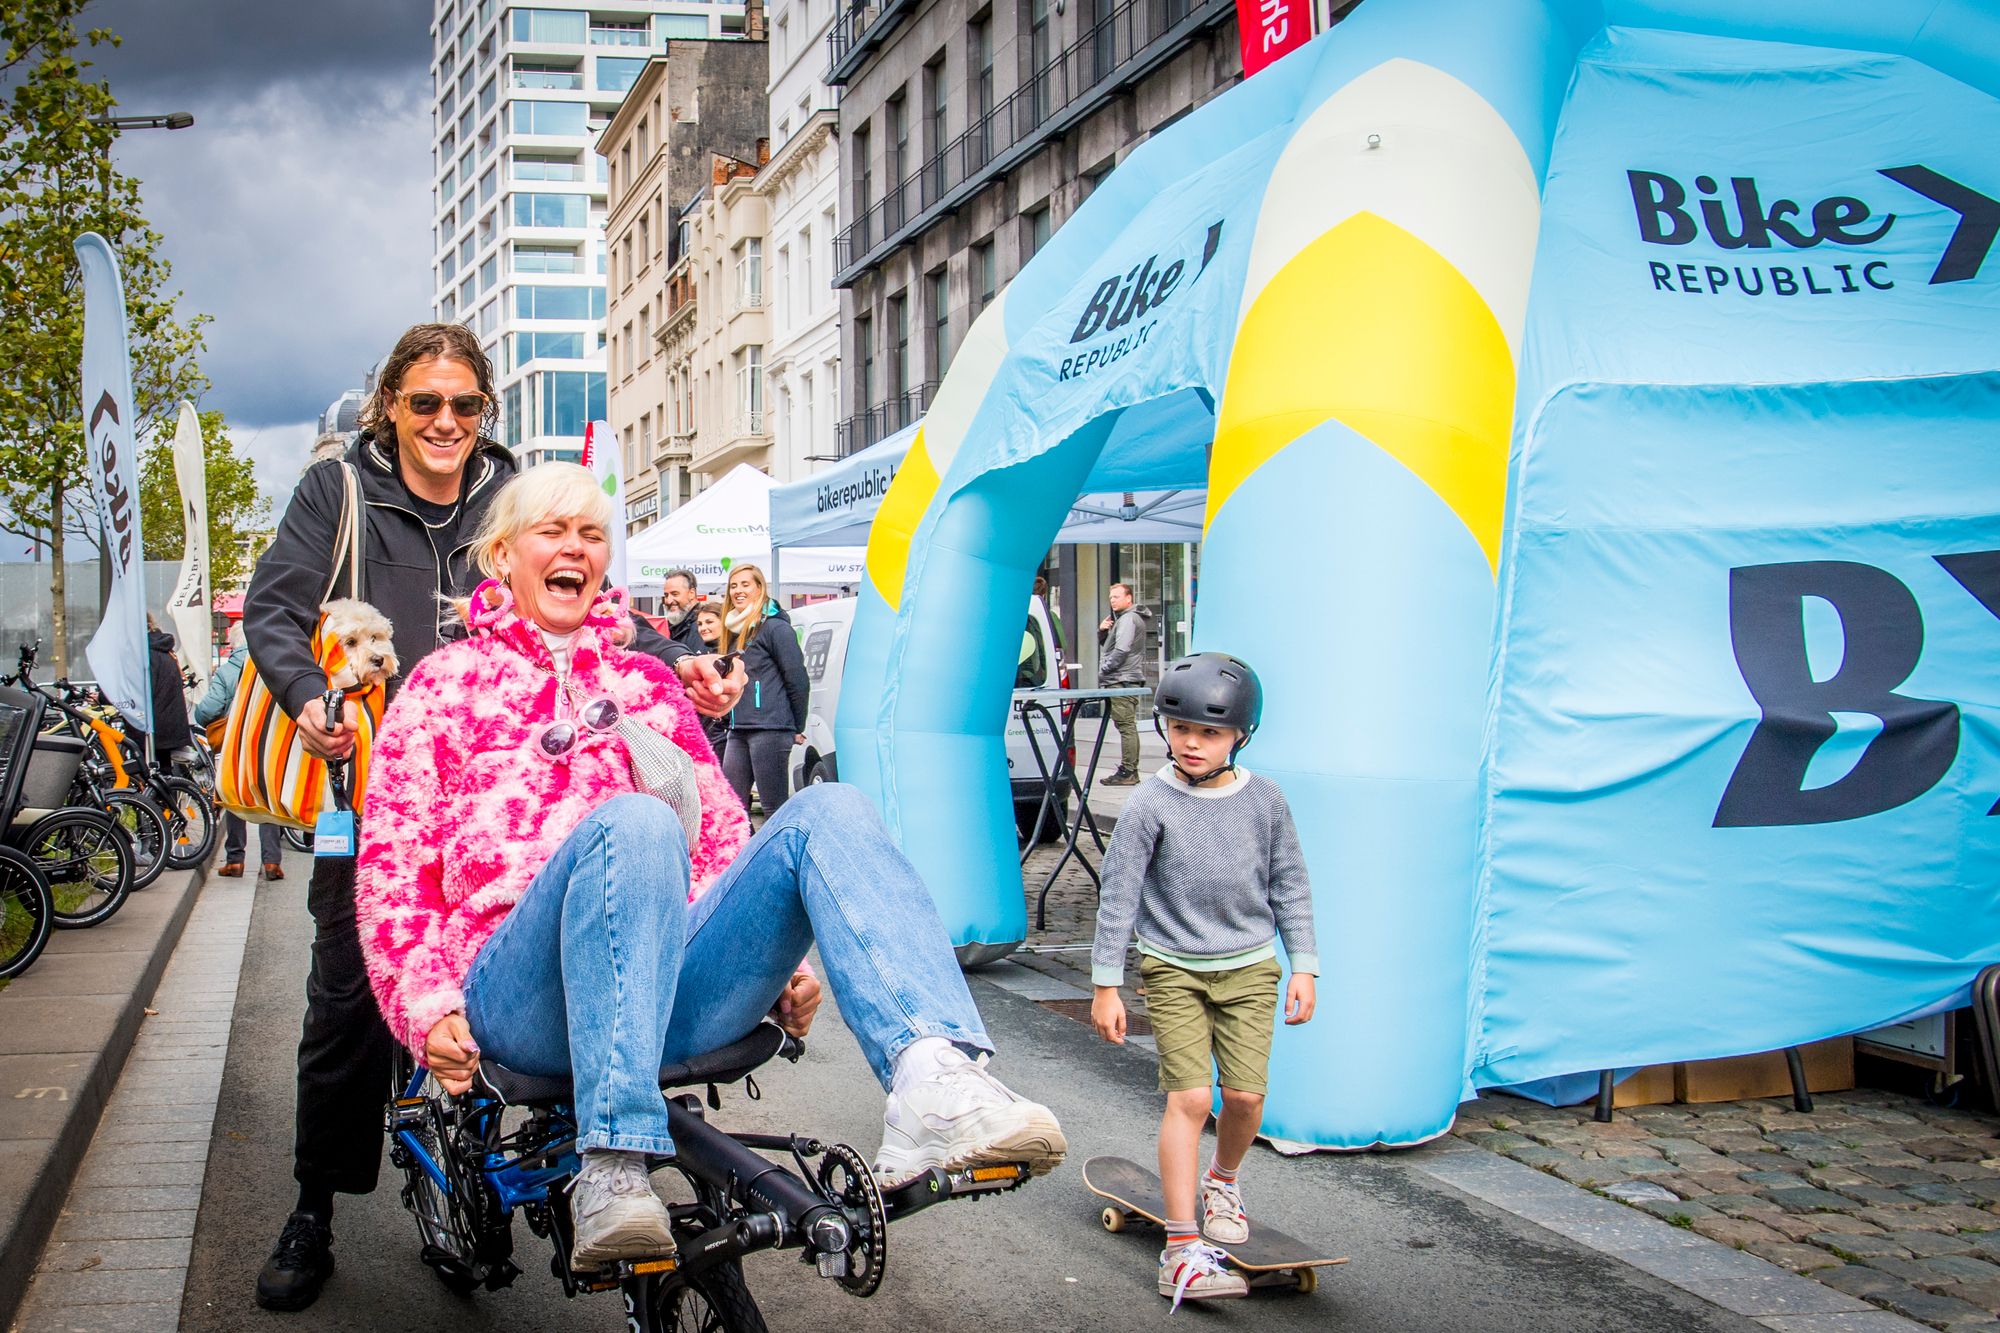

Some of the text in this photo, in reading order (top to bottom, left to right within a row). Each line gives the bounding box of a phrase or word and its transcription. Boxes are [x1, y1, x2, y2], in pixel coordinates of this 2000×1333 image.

[1626, 169, 1897, 250] Bike
[1069, 254, 1185, 344] Bike
[1649, 261, 1895, 296] REPUBLIC
[1712, 560, 1961, 828] B
